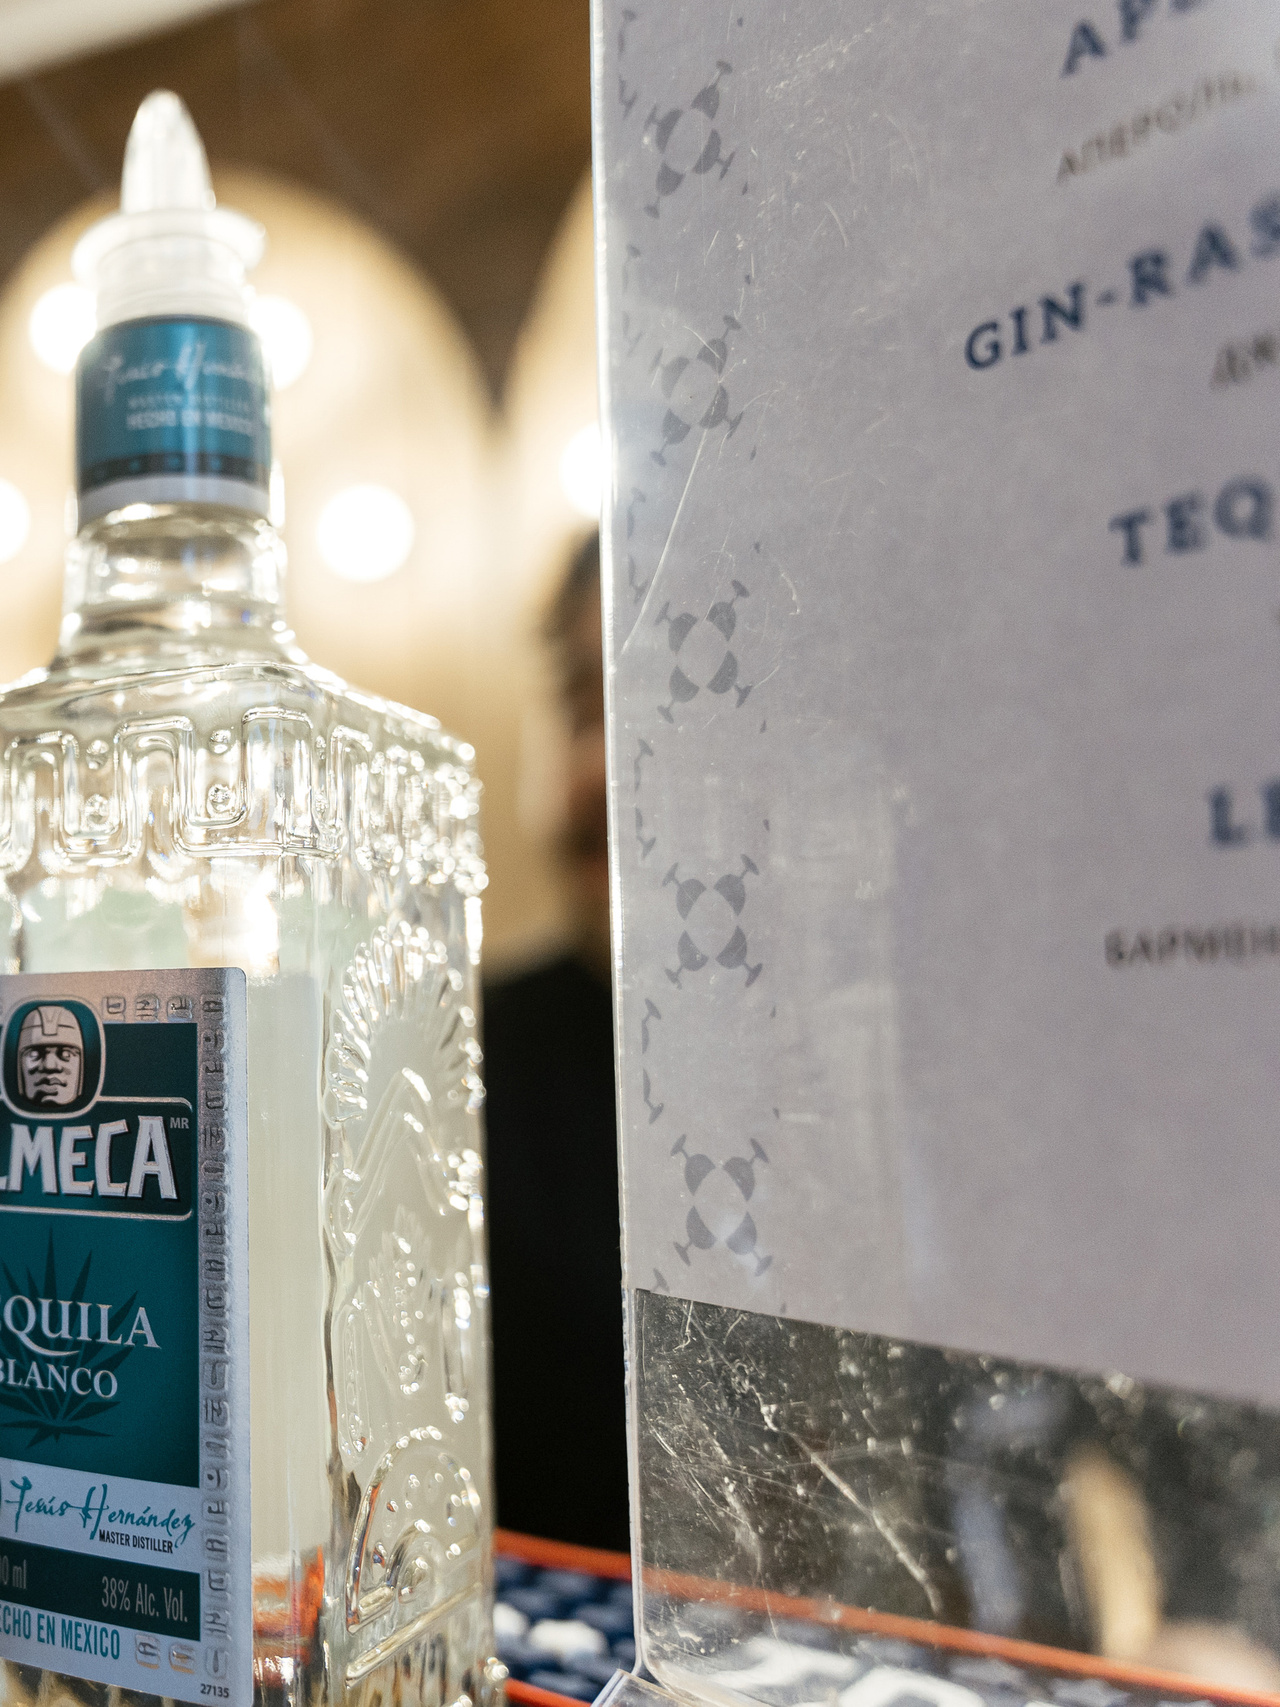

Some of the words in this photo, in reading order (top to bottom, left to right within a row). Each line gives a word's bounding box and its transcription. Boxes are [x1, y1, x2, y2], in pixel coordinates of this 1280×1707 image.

[1060, 0, 1202, 78] AP
[170, 1116, 190, 1130] MR
[72, 1483, 196, 1549] Hernández
[99, 1529, 131, 1547] MASTER
[132, 1534, 174, 1555] DISTILLER
[12, 1559, 27, 1590] ml
[101, 1575, 131, 1612] 38%
[135, 1582, 160, 1618] Alc.
[163, 1586, 189, 1623] Vol.
[36, 1612, 57, 1644] EN
[60, 1619, 121, 1660] MEXICO
[200, 1683, 230, 1698] 27135
